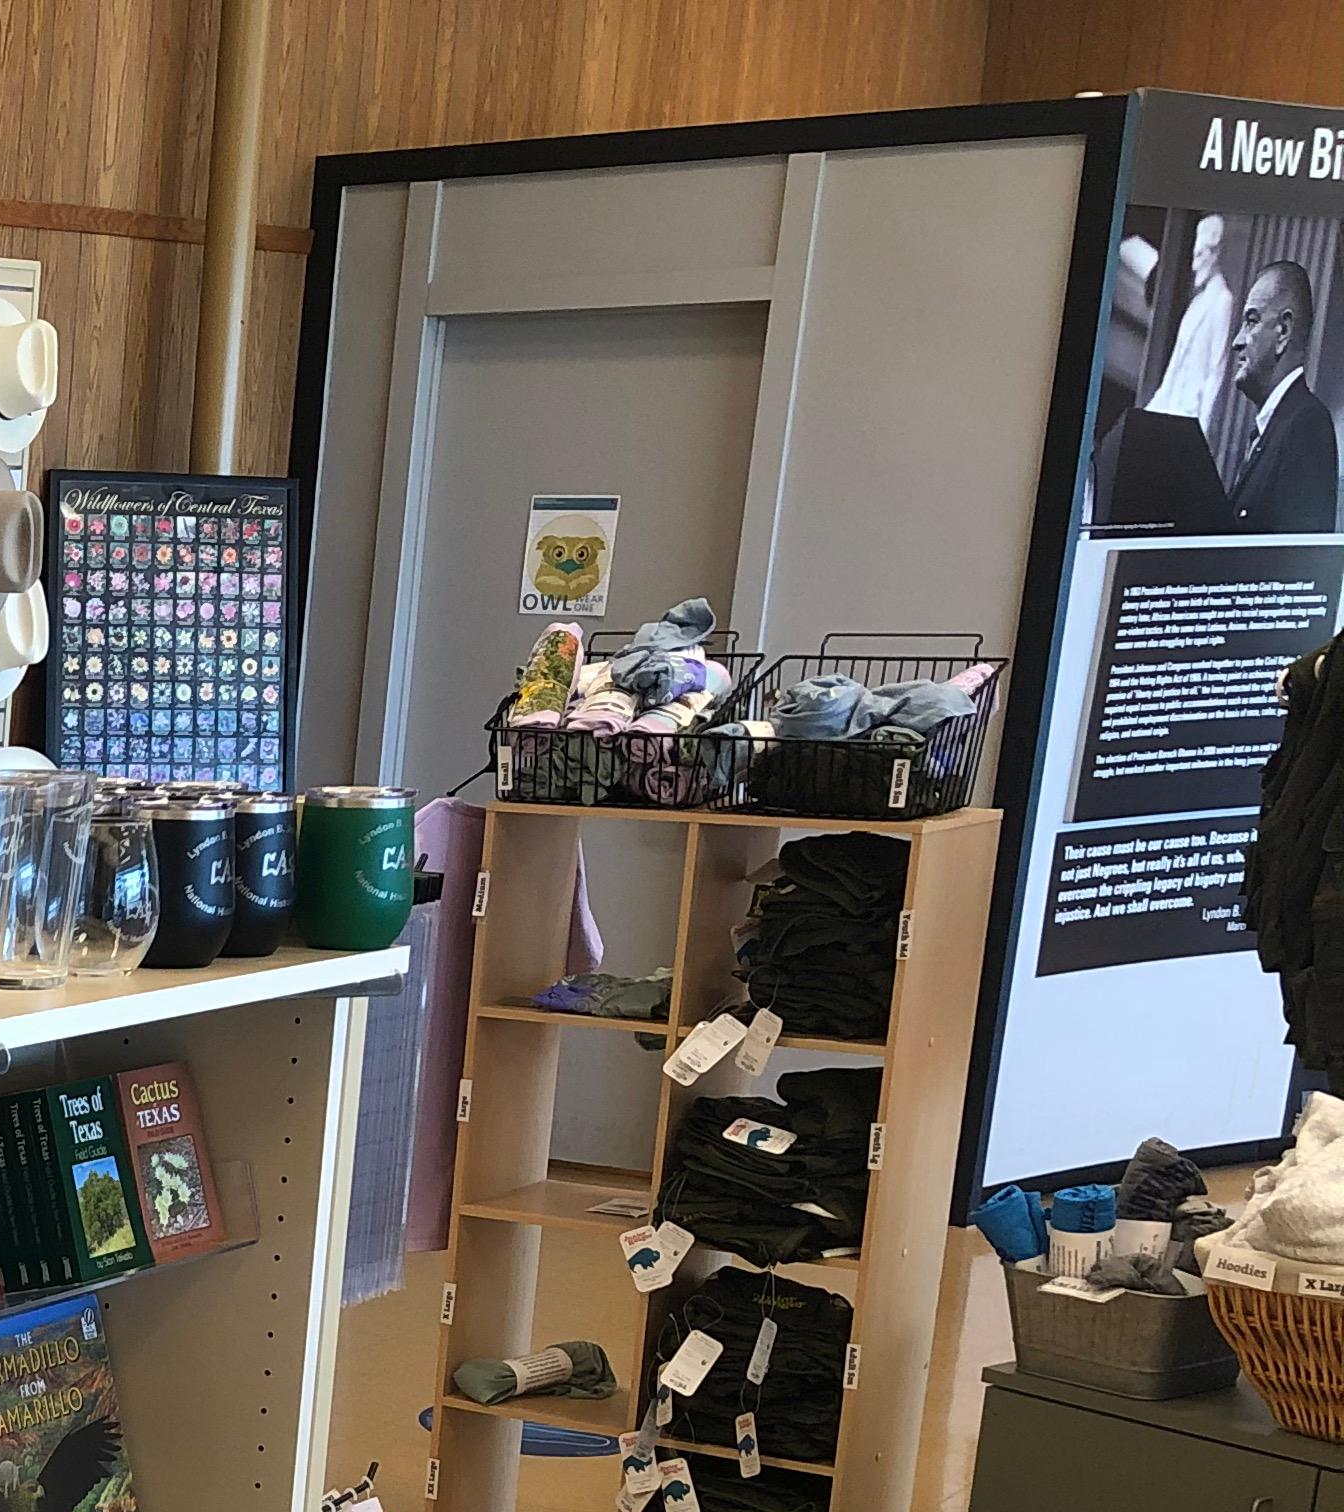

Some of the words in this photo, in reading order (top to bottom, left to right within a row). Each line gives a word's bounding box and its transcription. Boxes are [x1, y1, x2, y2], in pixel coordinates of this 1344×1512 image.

[1200, 118, 1222, 170] A
[1231, 120, 1305, 176] New
[1309, 127, 1344, 180] Bi
[64, 487, 154, 515] Wildflowers
[157, 497, 172, 515] of
[172, 491, 237, 514] Central
[237, 494, 284, 516] Texas
[523, 594, 572, 611] OWL
[574, 603, 593, 612] ONE
[1087, 844, 1111, 857] cause
[1113, 841, 1134, 854] must
[1136, 839, 1146, 852] be
[1164, 837, 1189, 849] cause
[1210, 831, 1249, 845] Because
[184, 885, 216, 915] National
[1094, 903, 1111, 917] And
[1127, 898, 1148, 914] shall
[58, 1091, 88, 1120] Trees
[90, 1086, 103, 1112] of
[130, 1078, 179, 1106] Cactus
[136, 1103, 180, 1127] TEXAS
[69, 1117, 103, 1143] Texas
[1216, 1258, 1268, 1280] Hoodies
[14, 1332, 34, 1347] THE
[20, 1381, 46, 1399] FROM
